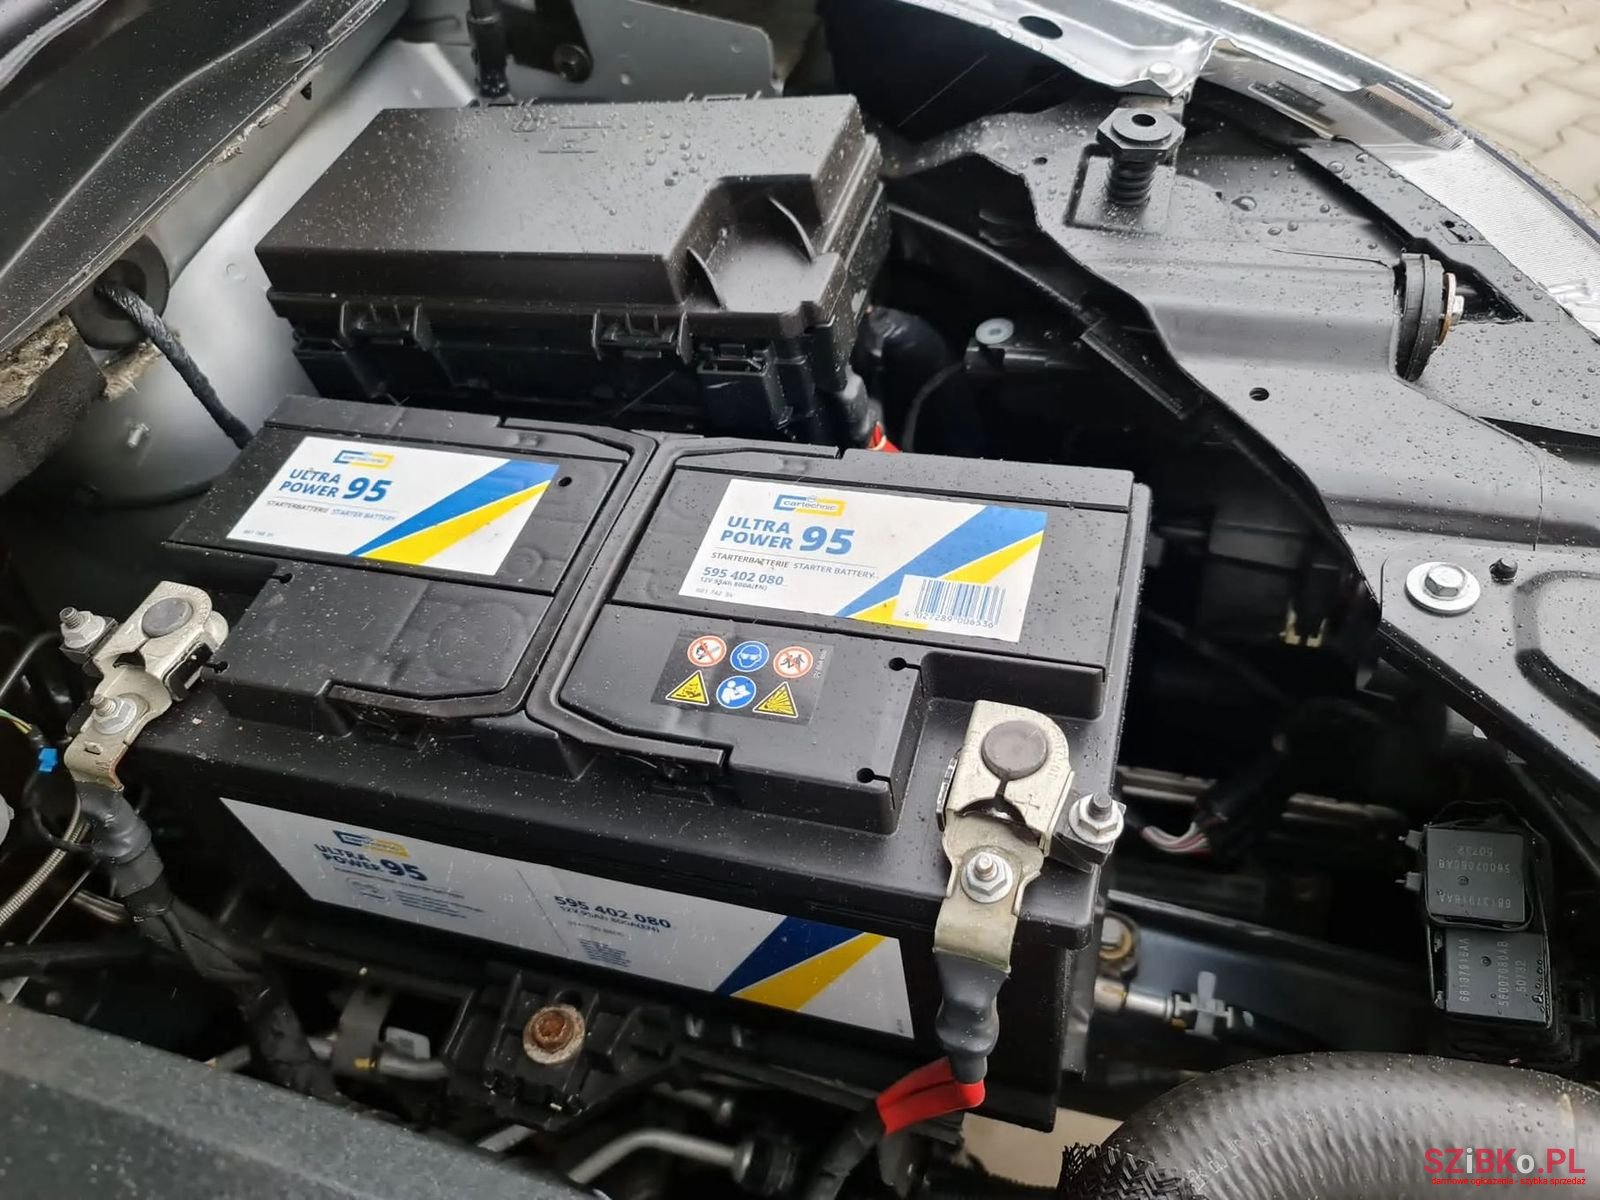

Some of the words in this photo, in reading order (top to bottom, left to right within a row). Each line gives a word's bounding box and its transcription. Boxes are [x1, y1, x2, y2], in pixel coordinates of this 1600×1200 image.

[289, 468, 342, 484] ULTRA
[279, 481, 340, 498] POWER
[342, 477, 393, 502] 95
[728, 515, 791, 534] ULTRA
[720, 529, 794, 550] POWER
[800, 525, 856, 555] 95
[711, 551, 790, 569] STARTERBATTERIE
[794, 562, 832, 574] STARTER
[703, 566, 728, 578] 595
[730, 571, 756, 583] 402
[758, 574, 784, 586] 080
[314, 843, 371, 862] ULTRA
[381, 858, 428, 881] 95
[554, 895, 590, 911] 595
[594, 905, 631, 921] 402
[634, 913, 672, 929] 080
